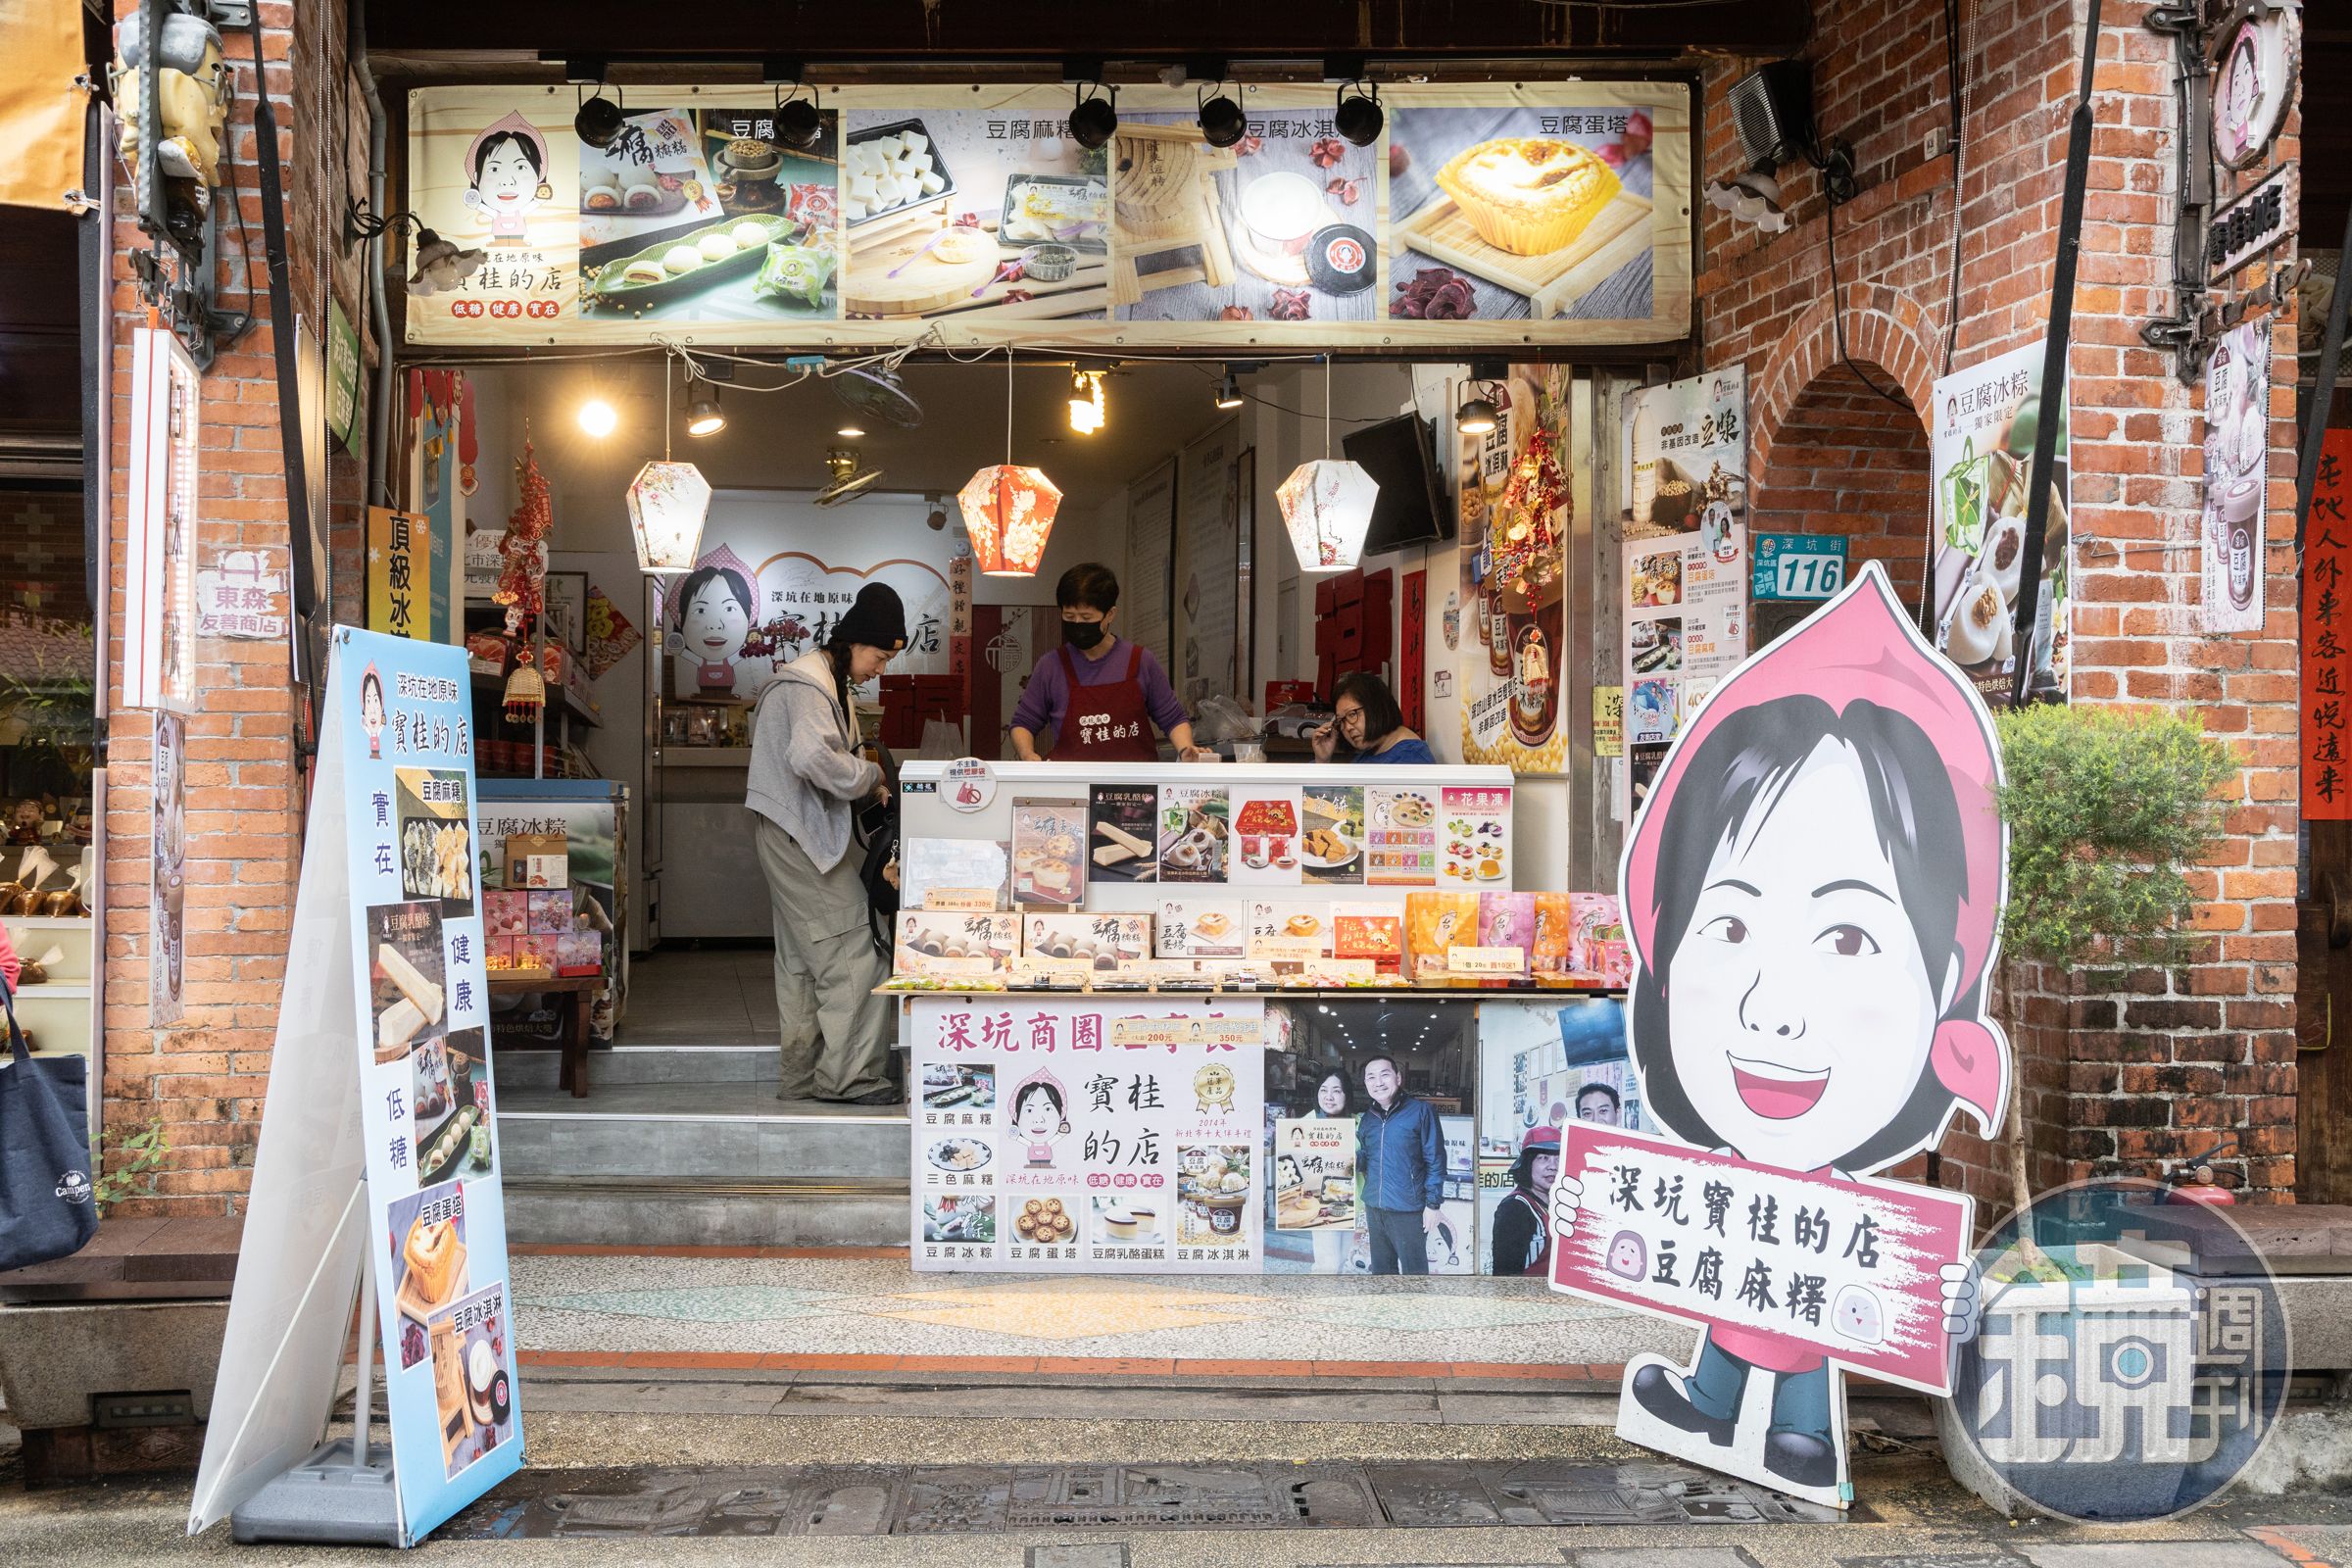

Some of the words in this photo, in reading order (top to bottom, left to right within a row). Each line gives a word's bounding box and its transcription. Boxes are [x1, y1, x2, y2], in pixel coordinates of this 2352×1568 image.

[1246, 118, 1343, 140] 豆腐冰淇
[1540, 115, 1629, 135] 豆腐蛋塔
[486, 252, 545, 264] 在地原味
[456, 267, 562, 292] 桂的店
[454, 303, 484, 317] 低糖
[492, 303, 520, 317] 健康
[1959, 368, 2029, 416] 豆腐冰粽
[1974, 405, 2014, 431] 獨家限定
[1700, 407, 1740, 450] 豆漿
[1660, 433, 1699, 451] 非基因改造
[1782, 538, 1842, 552] 深坑街
[1784, 559, 1839, 592] 116
[215, 586, 270, 610] 東森
[771, 590, 854, 605] 深坑在地原味
[397, 673, 459, 703] 深坑在地原味
[392, 709, 468, 759] 寶桂的店
[1079, 721, 1140, 745] 寶桂的店
[949, 767, 986, 776] 提供塑膠袋
[956, 760, 979, 768] 不主動
[421, 779, 462, 803] 豆腐麻糬
[1460, 792, 1504, 808] 花果凍
[371, 790, 394, 877] 實在
[477, 817, 567, 836] 豆腐冰粽
[1159, 922, 1188, 940] 豆腐
[451, 933, 472, 1012] 健康
[1219, 1034, 1244, 1043] 350元
[1084, 1073, 1165, 1114] 寶桂
[926, 1112, 993, 1126] 豆腐麻糬
[1199, 1118, 1227, 1128] 2014年
[386, 1088, 408, 1171] 低糖
[1176, 1128, 1252, 1139] 新北市十大伴手禮
[1083, 1128, 1160, 1167] 的店
[926, 1173, 994, 1186] 三色麻糬
[1005, 1172, 1080, 1186] 深坑在地原味
[1087, 1175, 1110, 1187] 低糖
[1113, 1175, 1137, 1187] 健康
[1141, 1175, 1164, 1187] 實在
[421, 1194, 463, 1228] 豆腐蛋塔
[1609, 1164, 1881, 1270] 深坑寶桂的店
[926, 1246, 993, 1259] 豆腐冰粽
[1010, 1248, 1077, 1260] 豆腐蛋塔
[1092, 1248, 1166, 1260] 豆腐乳酪蛋糕
[1177, 1249, 1251, 1261] 豆腐冰淇淋
[1650, 1239, 1828, 1328] 豆腐麻糬
[454, 1296, 503, 1335] 豆腐冰淇淋
